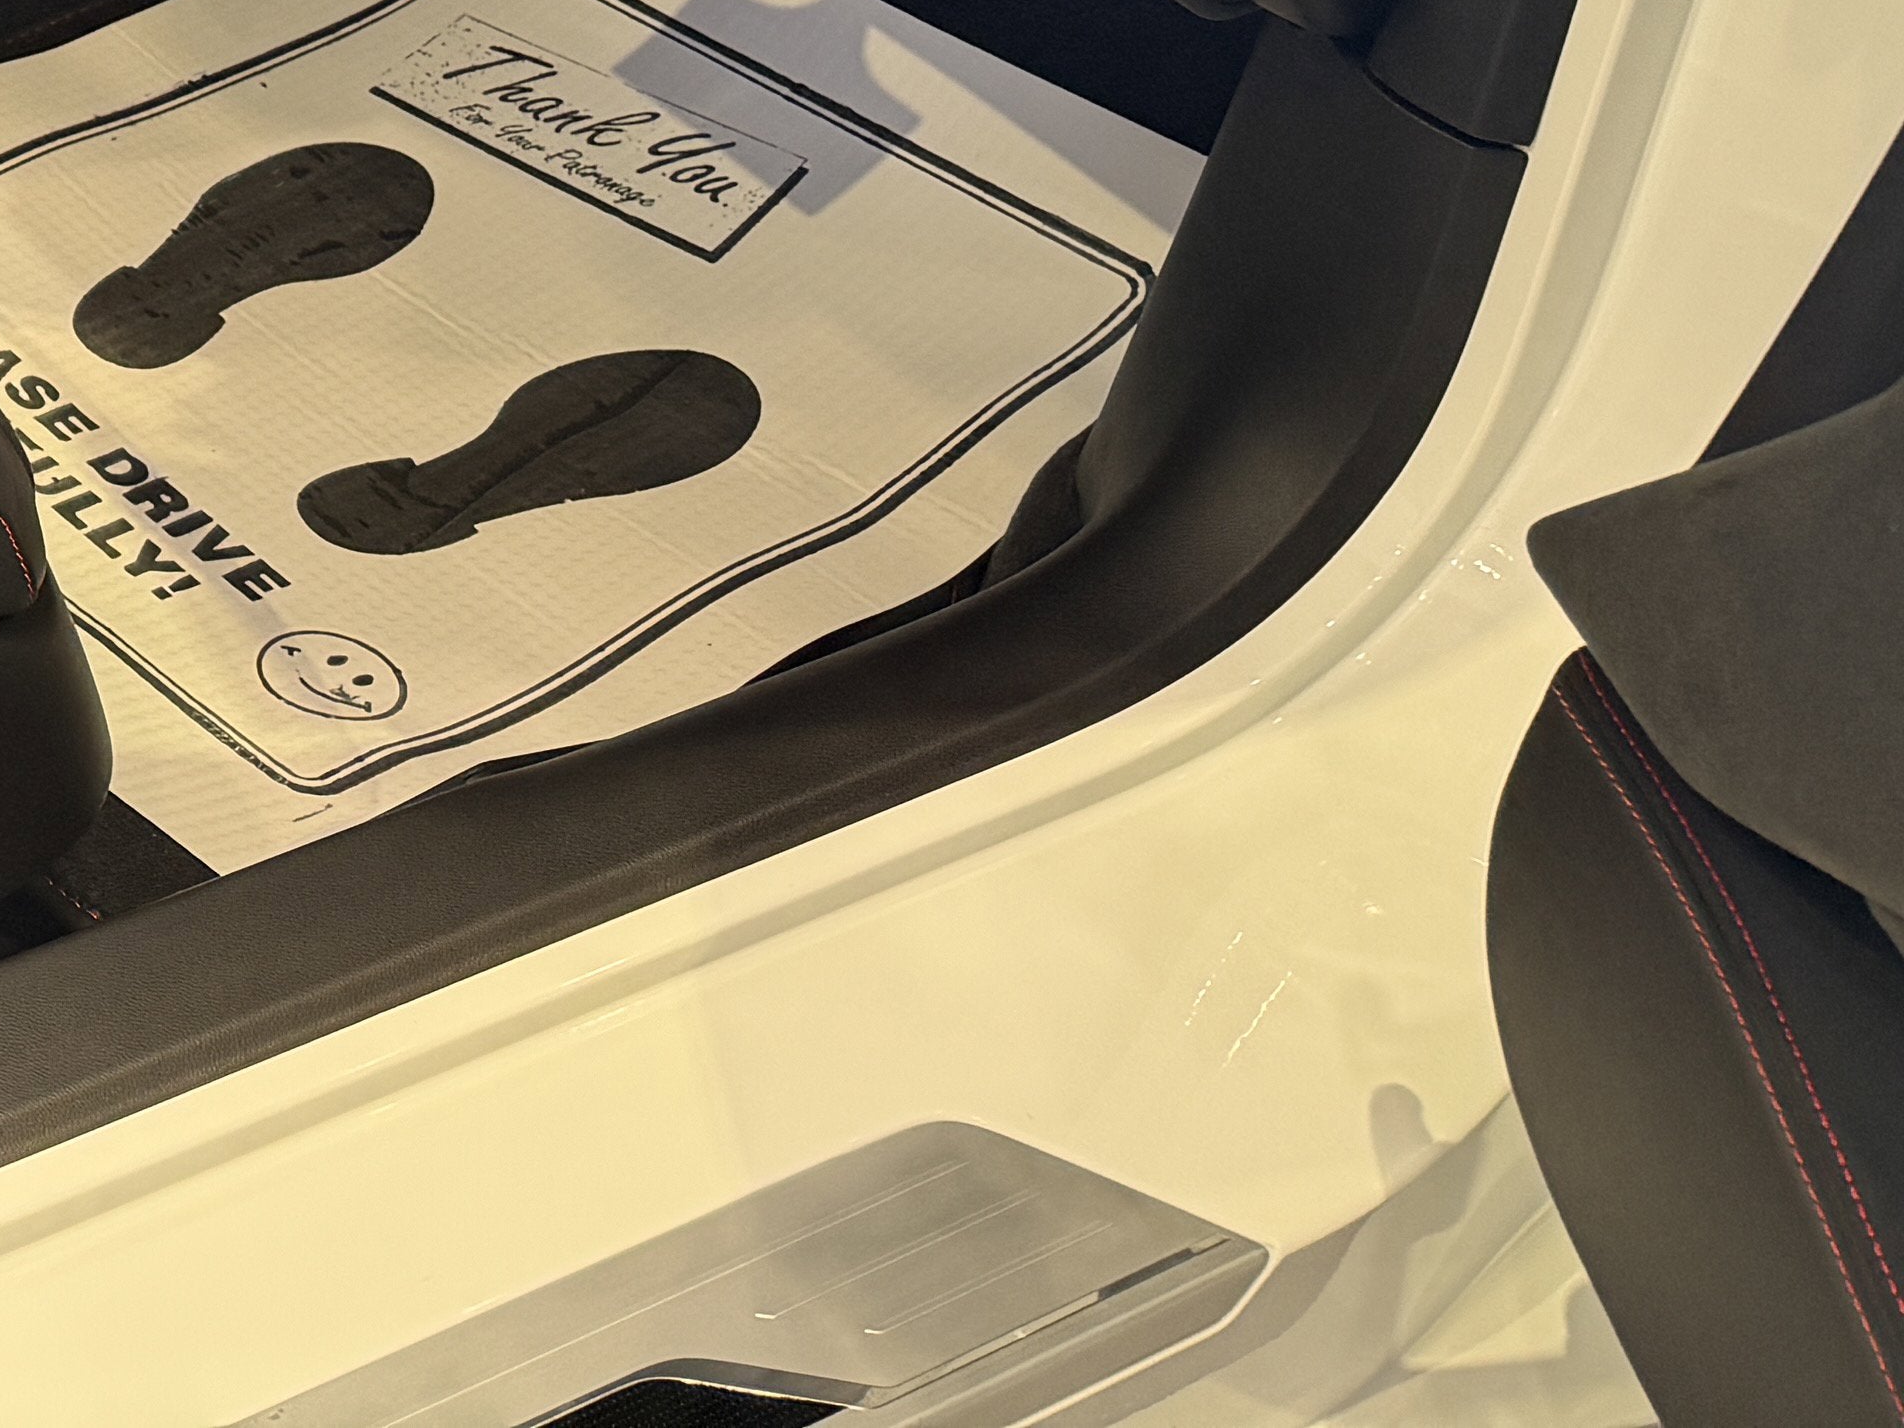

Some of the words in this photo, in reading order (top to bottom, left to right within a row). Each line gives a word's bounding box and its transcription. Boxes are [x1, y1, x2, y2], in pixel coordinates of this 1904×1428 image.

[442, 45, 661, 147] Thank
[449, 103, 493, 126] For
[86, 447, 292, 602] DRIVE
